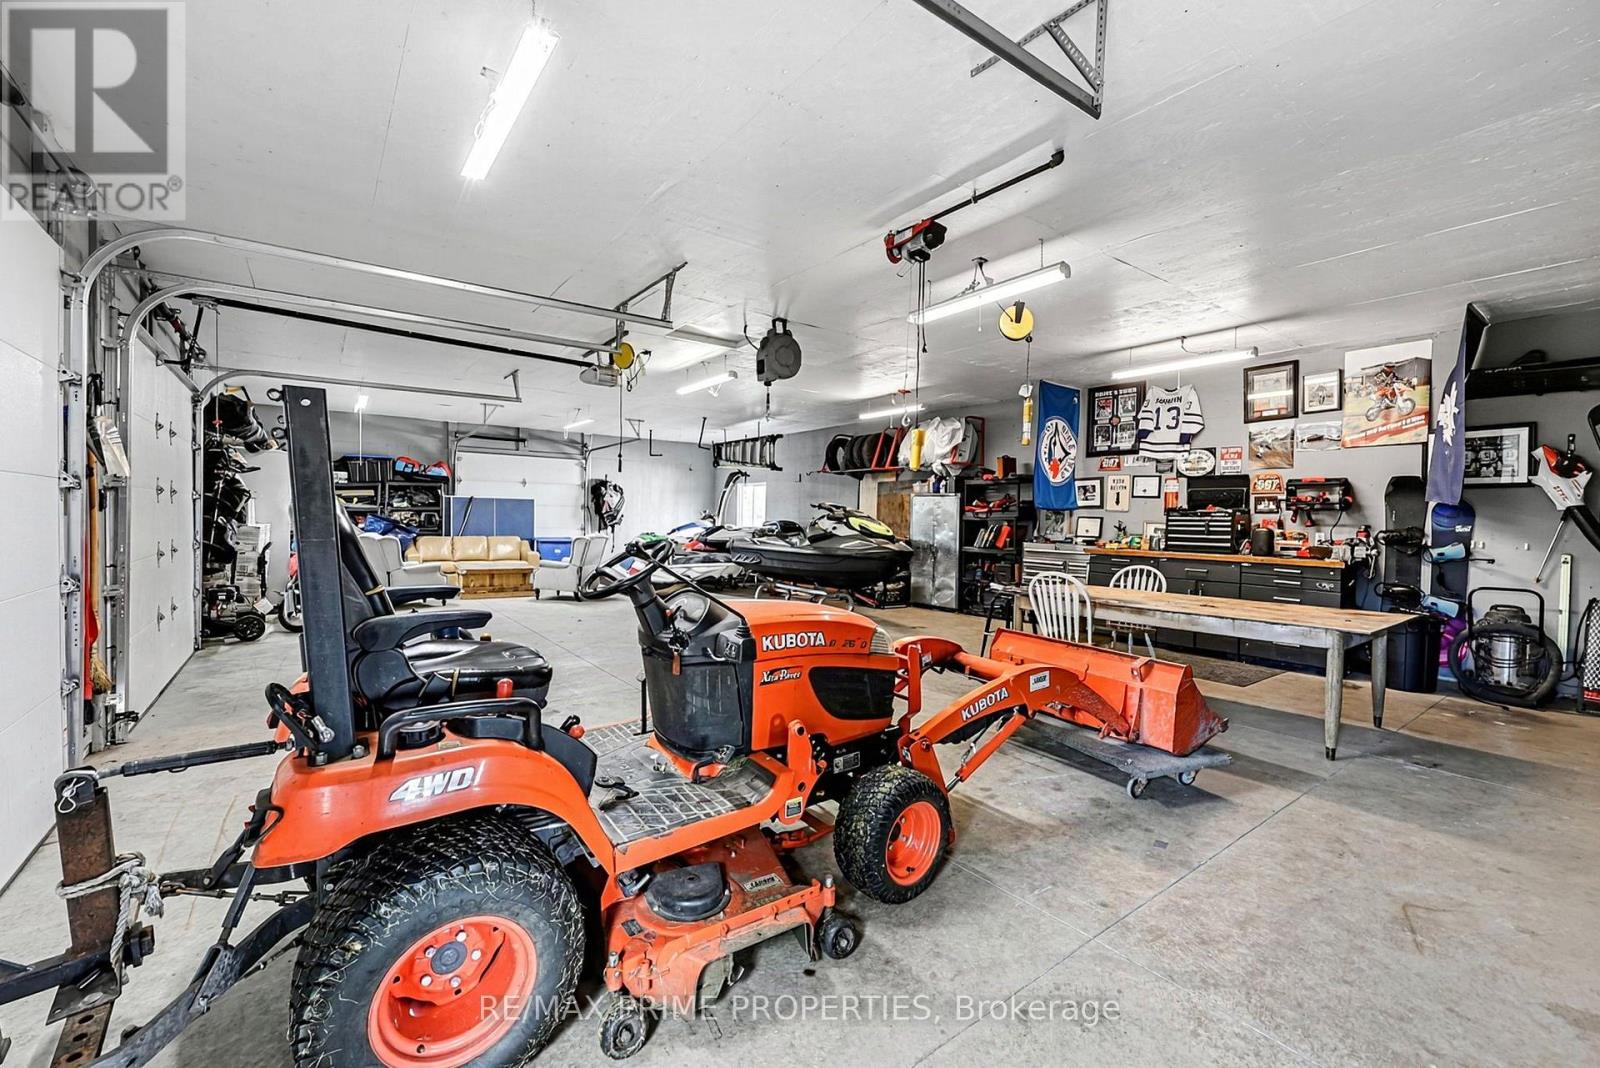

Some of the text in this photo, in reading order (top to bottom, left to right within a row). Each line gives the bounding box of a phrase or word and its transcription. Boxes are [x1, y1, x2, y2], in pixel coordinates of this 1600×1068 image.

[1154, 406, 1181, 431] 13
[761, 631, 826, 652] KUBOTA
[961, 687, 1009, 721] KUBOTA
[388, 766, 475, 802] 4WD
